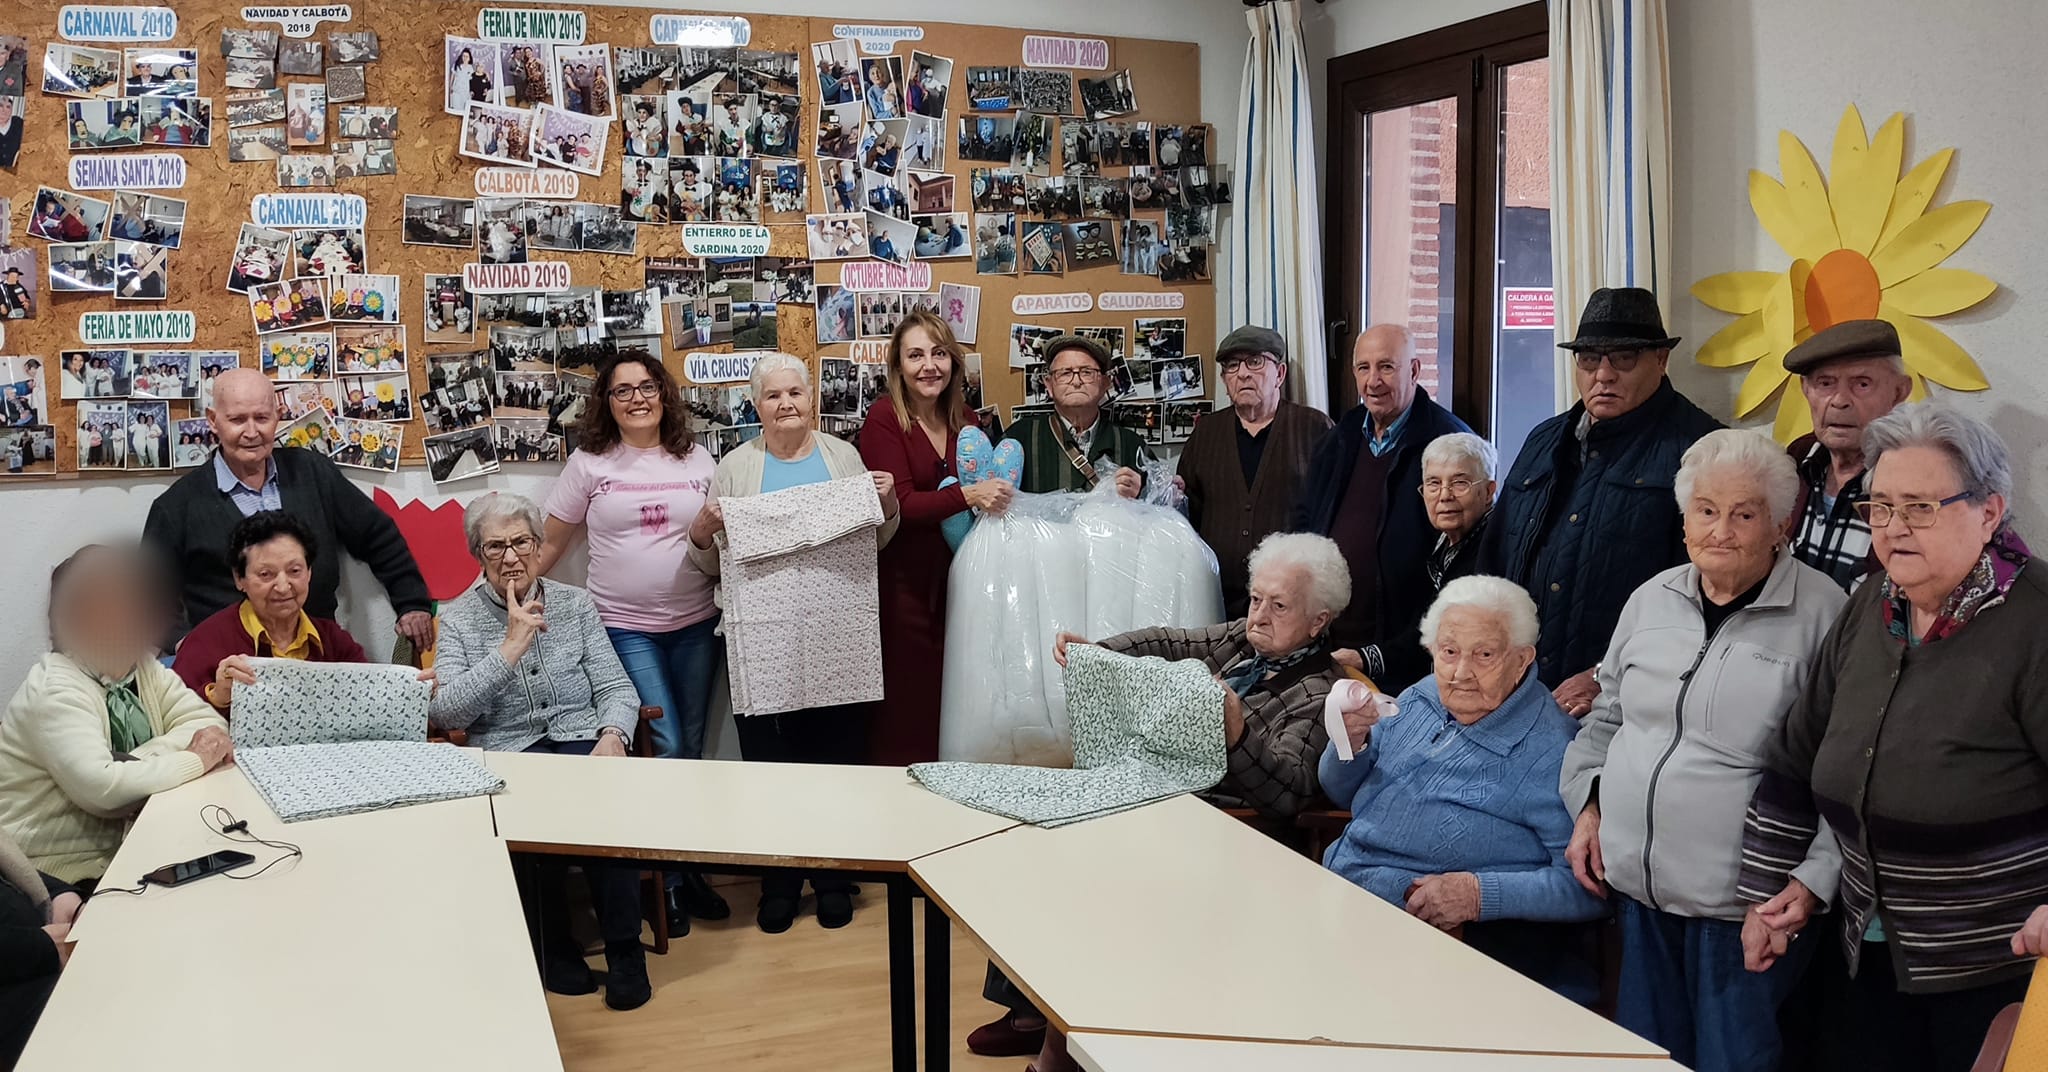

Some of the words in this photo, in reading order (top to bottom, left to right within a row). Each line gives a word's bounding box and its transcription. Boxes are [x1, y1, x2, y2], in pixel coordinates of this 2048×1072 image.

[245, 8, 290, 18] NAVIDAD
[293, 8, 300, 17] Y
[302, 7, 348, 17] CALBOTA
[64, 11, 138, 37] CARNAVAL
[141, 11, 173, 38] 2018
[287, 23, 311, 33] 2018
[483, 10, 512, 37] FERIA
[514, 11, 527, 38] DE
[530, 12, 557, 39] MAYO
[559, 13, 581, 40] 2019
[834, 26, 921, 38] CONFINAMIENTO
[865, 42, 891, 51] 2020
[1026, 37, 1077, 65] NAVIDAD
[1079, 40, 1106, 68] 2020
[75, 158, 119, 186] SEMANA
[121, 158, 155, 185] SANTA
[158, 157, 182, 186] 2018
[478, 172, 540, 194] CALBOTA
[544, 174, 575, 194] 2019
[258, 199, 329, 226] CARNAVAL
[332, 199, 363, 226] 2019
[685, 228, 736, 238] ENTIERRO
[739, 228, 753, 238] DE
[755, 229, 769, 238] LA
[693, 244, 738, 254] SARDINA
[741, 244, 765, 254] 2020
[468, 265, 530, 289] NAVIDAD
[535, 264, 568, 288] 2019
[844, 263, 884, 289] OCTUBRE
[886, 263, 908, 289] ROSA
[909, 263, 929, 288] 2020
[1016, 294, 1091, 311] APARATOS
[1101, 295, 1183, 308] SALUDABLES
[1507, 294, 1538, 302] CALDERA
[1538, 294, 1544, 302] A
[1544, 294, 1554, 302] GA
[84, 313, 116, 340] FERIA
[118, 314, 132, 339] DE
[134, 314, 164, 340] MAYO
[166, 314, 191, 339] 2018
[690, 355, 709, 379] VÍA
[711, 357, 750, 378] CRUCIS
